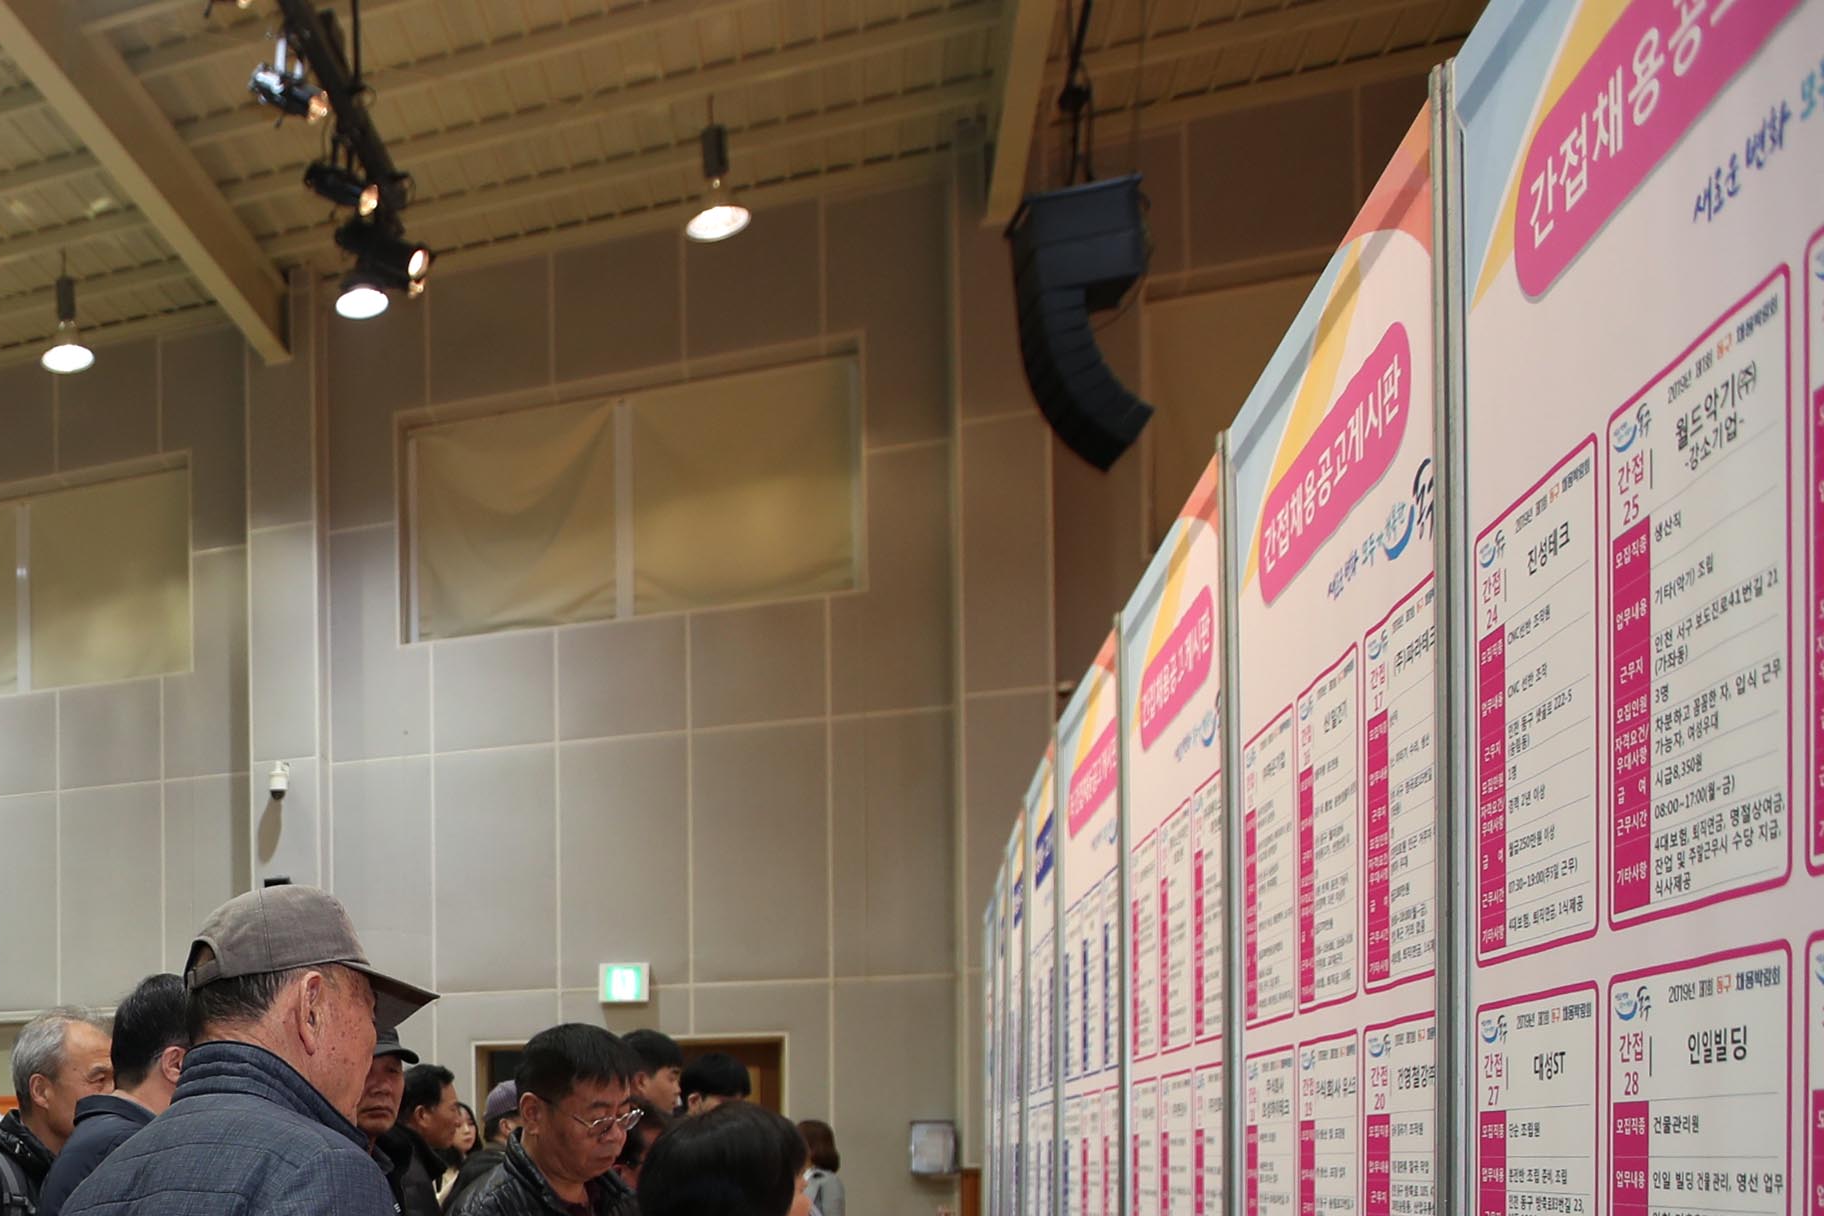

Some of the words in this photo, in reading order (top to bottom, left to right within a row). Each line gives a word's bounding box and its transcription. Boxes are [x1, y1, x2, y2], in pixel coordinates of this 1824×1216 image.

[1676, 360, 1757, 451] 월드악기(주)
[1264, 354, 1403, 574] 간접채용공고게시판
[1618, 449, 1644, 495] 간접
[1624, 494, 1639, 525] 25
[1655, 511, 1682, 542] 생산직
[1527, 521, 1570, 576] 진성테크
[1615, 534, 1647, 568] 모집직종
[1483, 568, 1501, 604] 간접
[1655, 568, 1695, 605] 기타(악기)
[1698, 553, 1714, 578] 조립
[1487, 604, 1498, 630] 24
[1616, 598, 1647, 631] 업무내용
[1655, 629, 1673, 653] 인천
[1676, 619, 1692, 640] 서구
[1620, 656, 1643, 684] 근무지
[1736, 668, 1757, 695] 입식
[1762, 657, 1781, 684] 근무
[1655, 684, 1669, 703] 3명
[1616, 694, 1647, 724] 모집인원
[1687, 711, 1719, 741] 여성우대
[1616, 746, 1647, 774] 우대사항
[1617, 811, 1648, 836] 근무시간
[1732, 827, 1754, 850] 수당
[1617, 861, 1647, 885] 기타사항
[1655, 871, 1691, 897] 식사제공
[1668, 983, 1695, 1003] 2019년
[1717, 974, 1731, 993] 동구
[1736, 965, 1781, 991] 채용박람회
[1619, 1031, 1643, 1063] 간접
[1688, 1025, 1747, 1065] 인일빌딩
[1371, 1066, 1388, 1087] 간접
[1484, 1052, 1502, 1078] 간접
[1534, 1052, 1566, 1080] 대성ST
[1488, 1086, 1499, 1105] 27
[1624, 1072, 1639, 1095] 28
[1374, 1093, 1385, 1110] 20
[1616, 1117, 1645, 1135] 모집직종
[1654, 1115, 1699, 1134] 건물관리원
[1616, 1171, 1645, 1189] 업무내용
[1653, 1172, 1671, 1190] 인일
[1676, 1172, 1693, 1190] 빌딩
[1697, 1172, 1710, 1191] 건물
[1737, 1173, 1758, 1193] 영선
[1764, 1174, 1783, 1194] 업무
